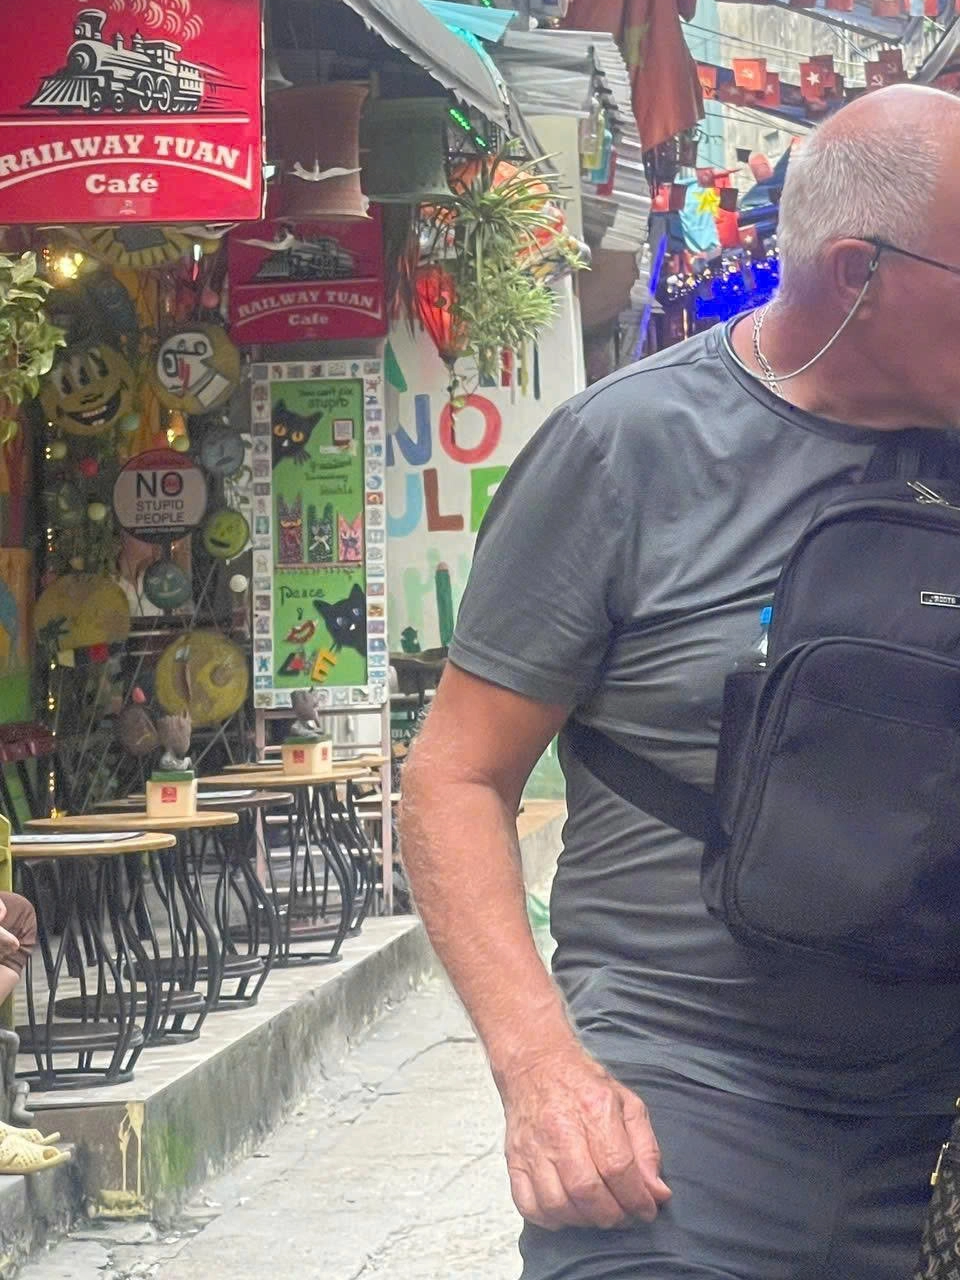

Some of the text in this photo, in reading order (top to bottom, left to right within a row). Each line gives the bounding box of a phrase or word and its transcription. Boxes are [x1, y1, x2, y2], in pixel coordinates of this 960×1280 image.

[0, 134, 240, 177] RAILWAY TUAN
[85, 173, 159, 194] Café
[238, 291, 374, 318] RAILWAY TUAN
[386, 393, 502, 465] NO
[136, 471, 184, 498] NO
[135, 511, 185, 524] PEOPLE
[136, 499, 184, 511] STUPID
